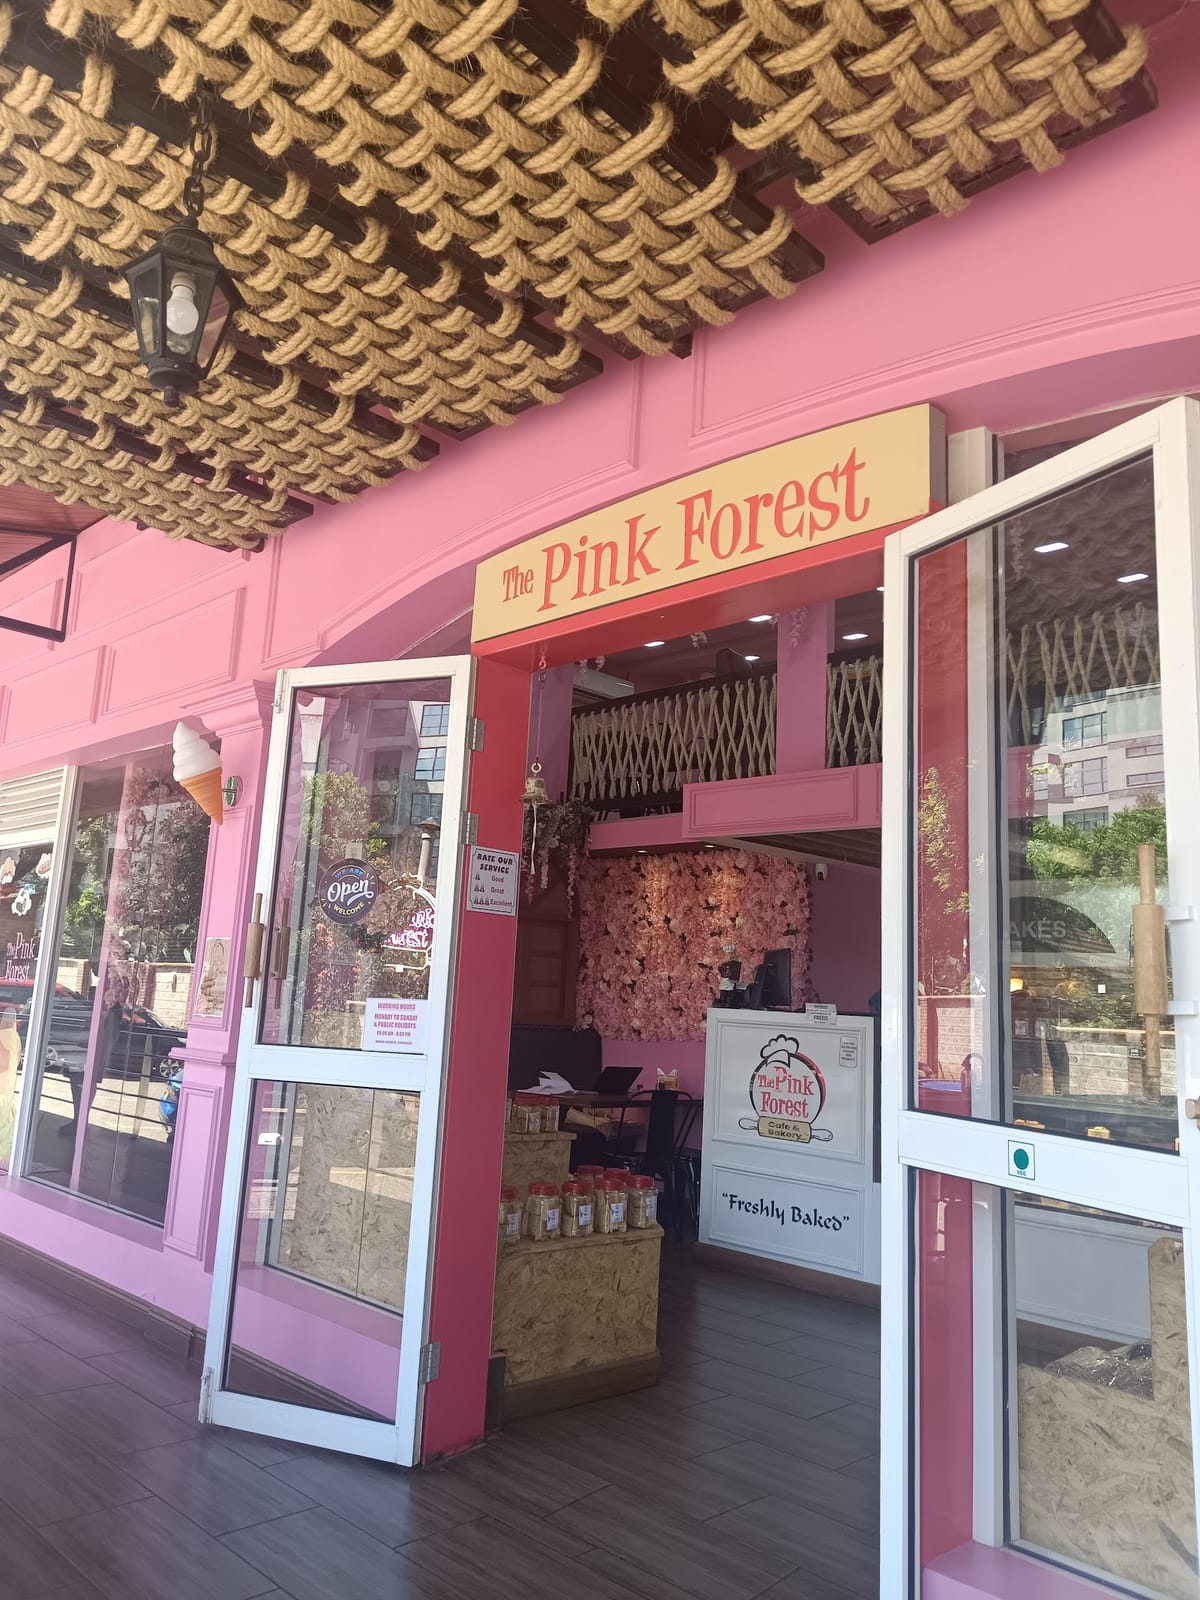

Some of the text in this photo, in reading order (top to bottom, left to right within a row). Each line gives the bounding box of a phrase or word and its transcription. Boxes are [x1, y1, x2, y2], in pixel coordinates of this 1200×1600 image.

[502, 447, 870, 612] The Pink Forest
[477, 853, 513, 866] RATE OUR
[480, 863, 510, 874] SERVICE
[327, 879, 374, 906] Open
[333, 901, 365, 915] WELCOME
[1009, 920, 1067, 938] AKES
[13, 932, 35, 959] Pink
[5, 960, 30, 982] Forest
[757, 1065, 815, 1096] The Pink
[760, 1091, 809, 1119] Forest
[767, 1128, 802, 1140] Bakery
